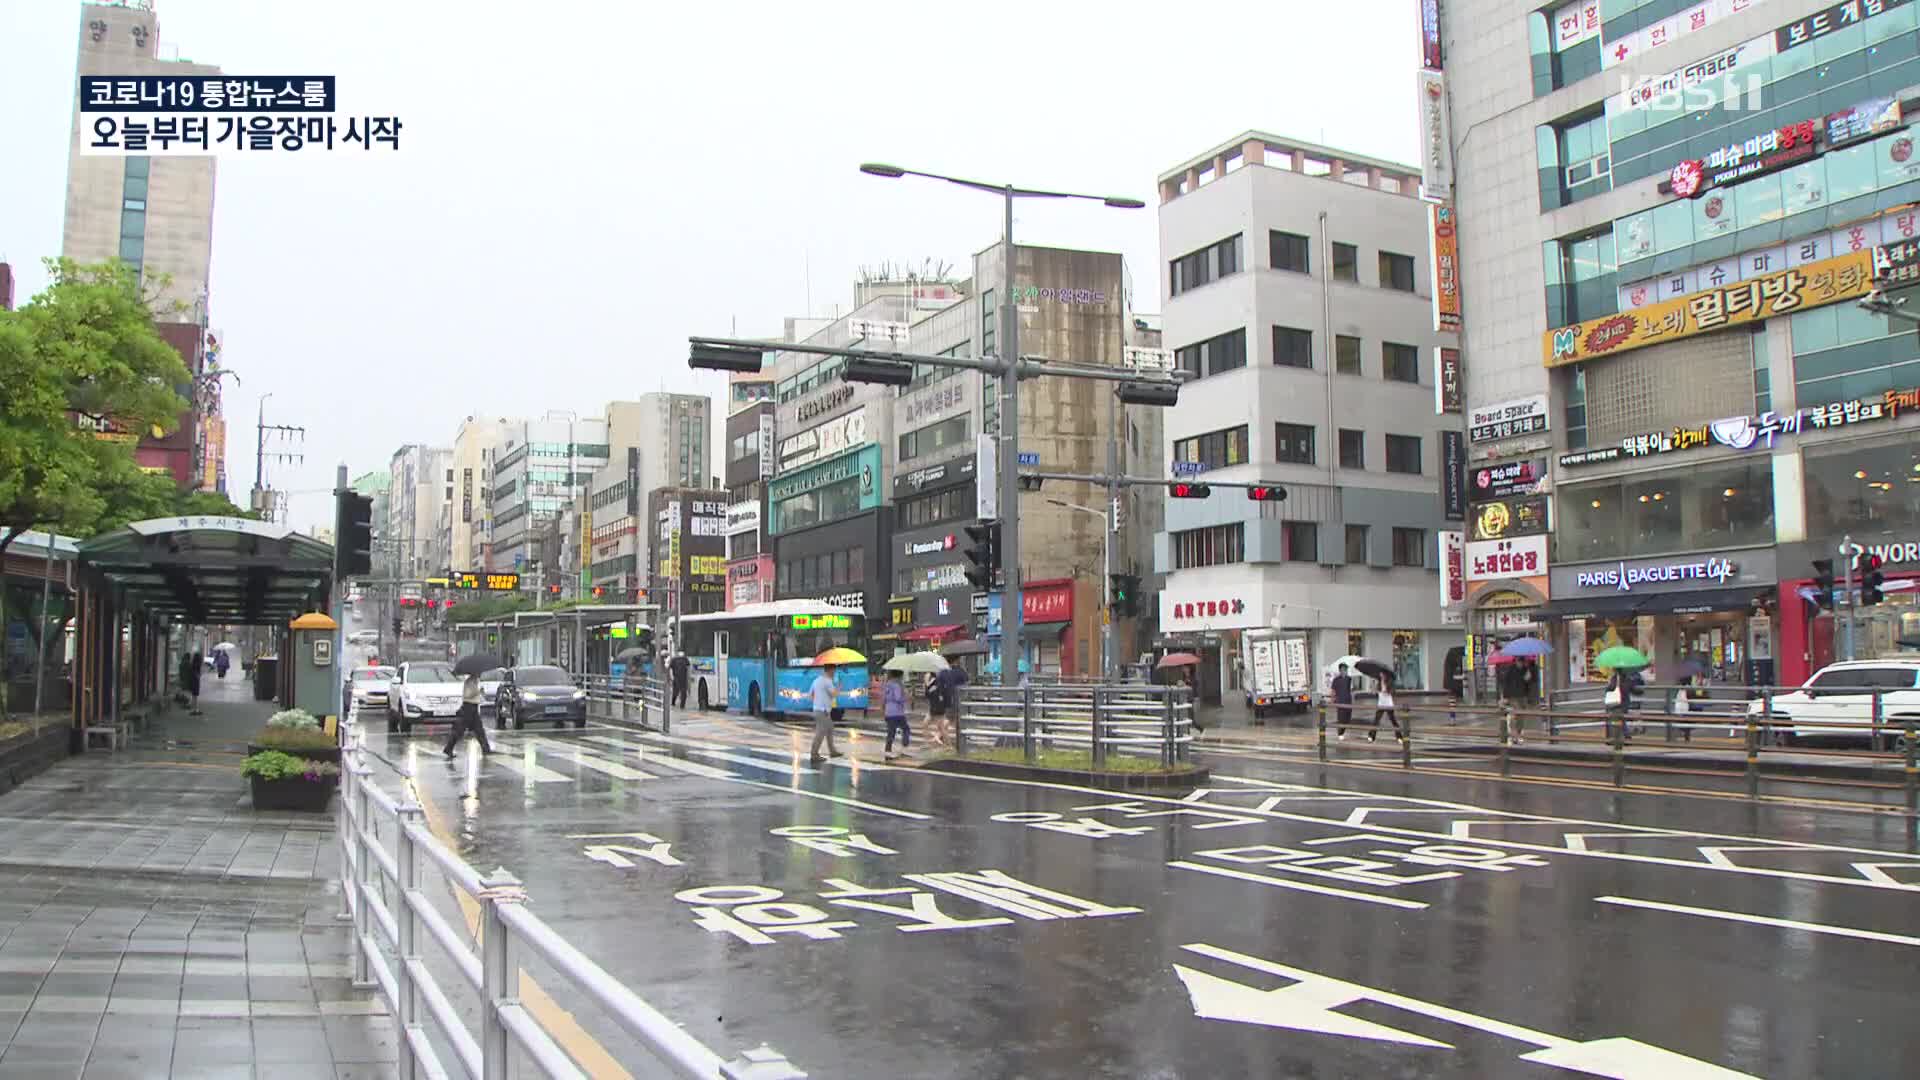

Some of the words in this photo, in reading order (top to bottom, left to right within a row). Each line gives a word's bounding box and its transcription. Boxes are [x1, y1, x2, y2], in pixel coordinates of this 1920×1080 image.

[1685, 52, 1737, 84] Space
[1641, 308, 1686, 340] 노래
[1688, 271, 1808, 328] 멀티방
[1809, 263, 1867, 299] 영화
[1475, 409, 1502, 424] Board
[1505, 405, 1533, 419] Space
[1757, 410, 1802, 448] 두끼
[1474, 551, 1538, 575] 노래연습장
[1867, 543, 1920, 563] WOR
[1578, 570, 1619, 587] PARIS
[1628, 563, 1707, 584] BAGUETTE
[1174, 599, 1240, 619] ARTBOX
